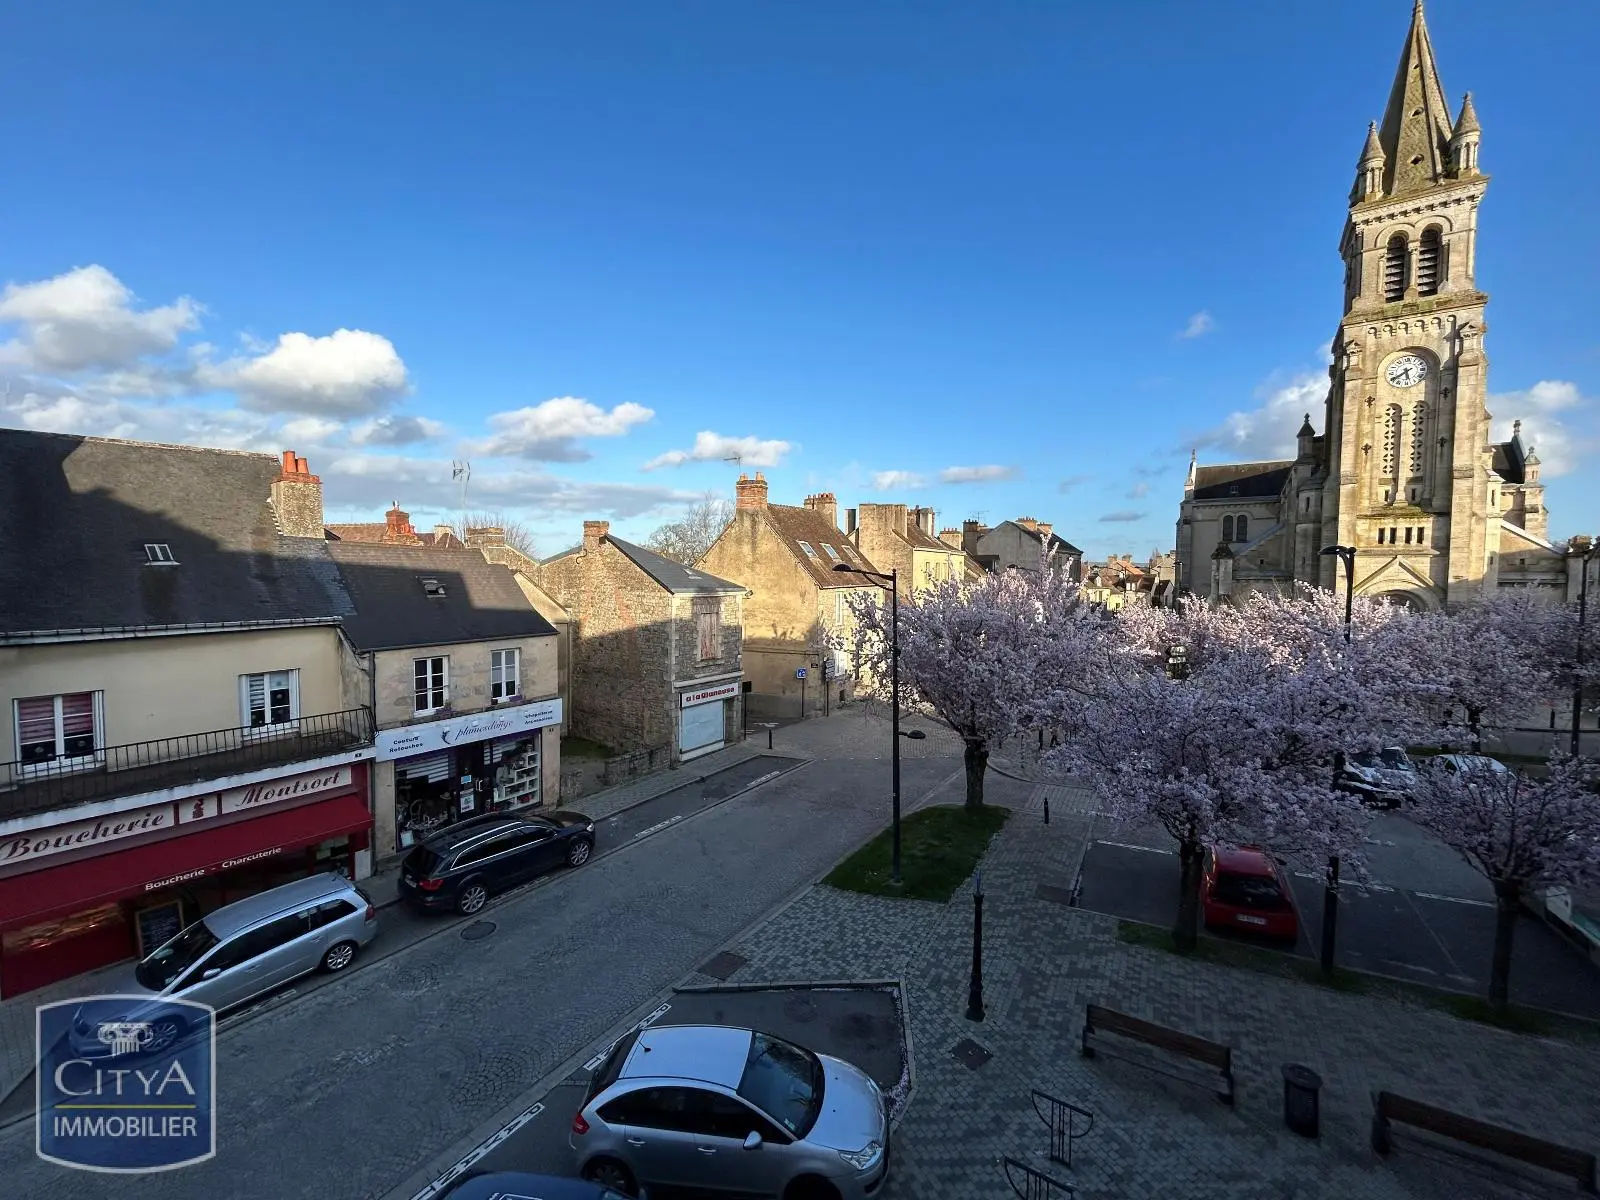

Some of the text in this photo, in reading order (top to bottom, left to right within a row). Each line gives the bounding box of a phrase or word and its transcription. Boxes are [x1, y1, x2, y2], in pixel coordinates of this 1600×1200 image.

[0, 771, 340, 861] Boucherie Montsort
[144, 869, 205, 891] Boucherie
[221, 847, 282, 868] Charcuterie
